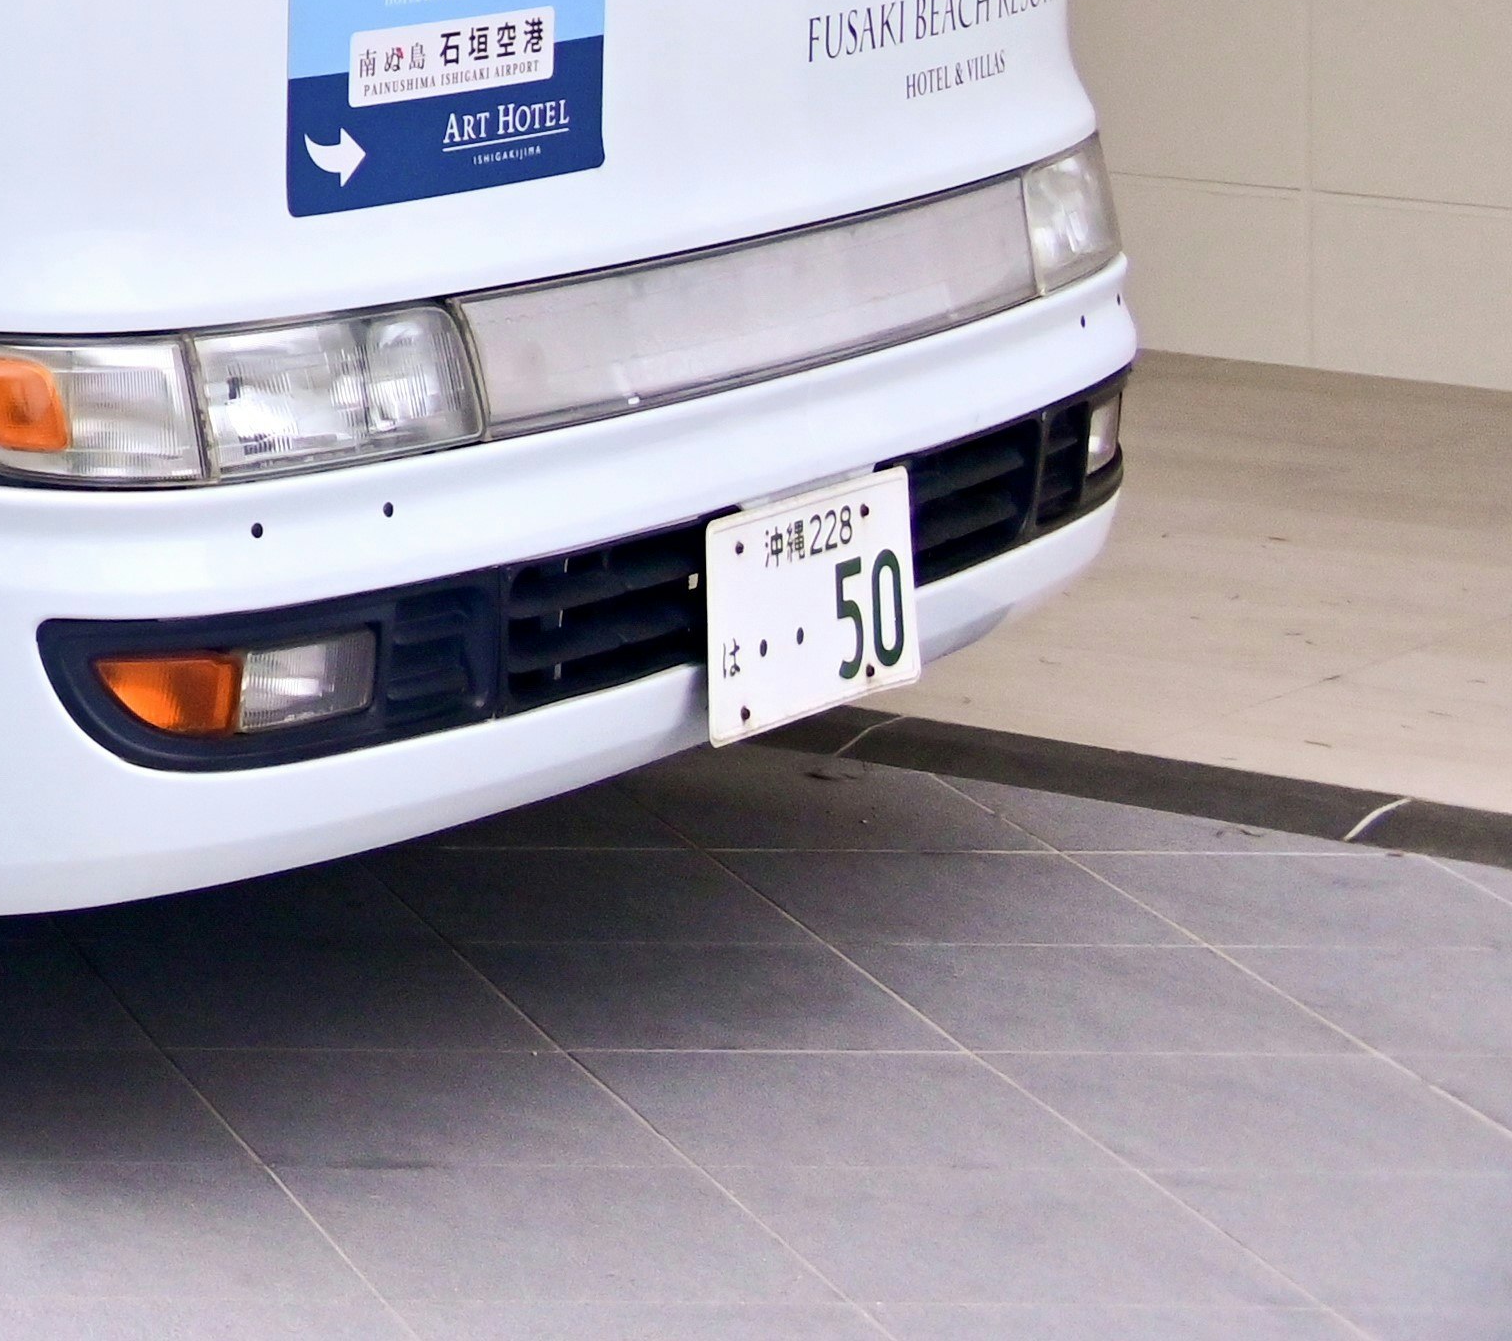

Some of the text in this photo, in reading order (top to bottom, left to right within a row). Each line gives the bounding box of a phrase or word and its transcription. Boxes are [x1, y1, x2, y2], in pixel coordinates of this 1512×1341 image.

[439, 17, 545, 67] 石垣空港
[807, 0, 905, 63] FUSAKI
[363, 59, 539, 97] PAINUSHIMA ISHIGAKI AIRPORT
[905, 49, 1006, 100] HOTEL & VILLAS
[443, 99, 570, 144] ART HOTEL
[764, 505, 853, 568] 沖縄 228
[835, 548, 905, 680] 50
[722, 638, 741, 679] は
